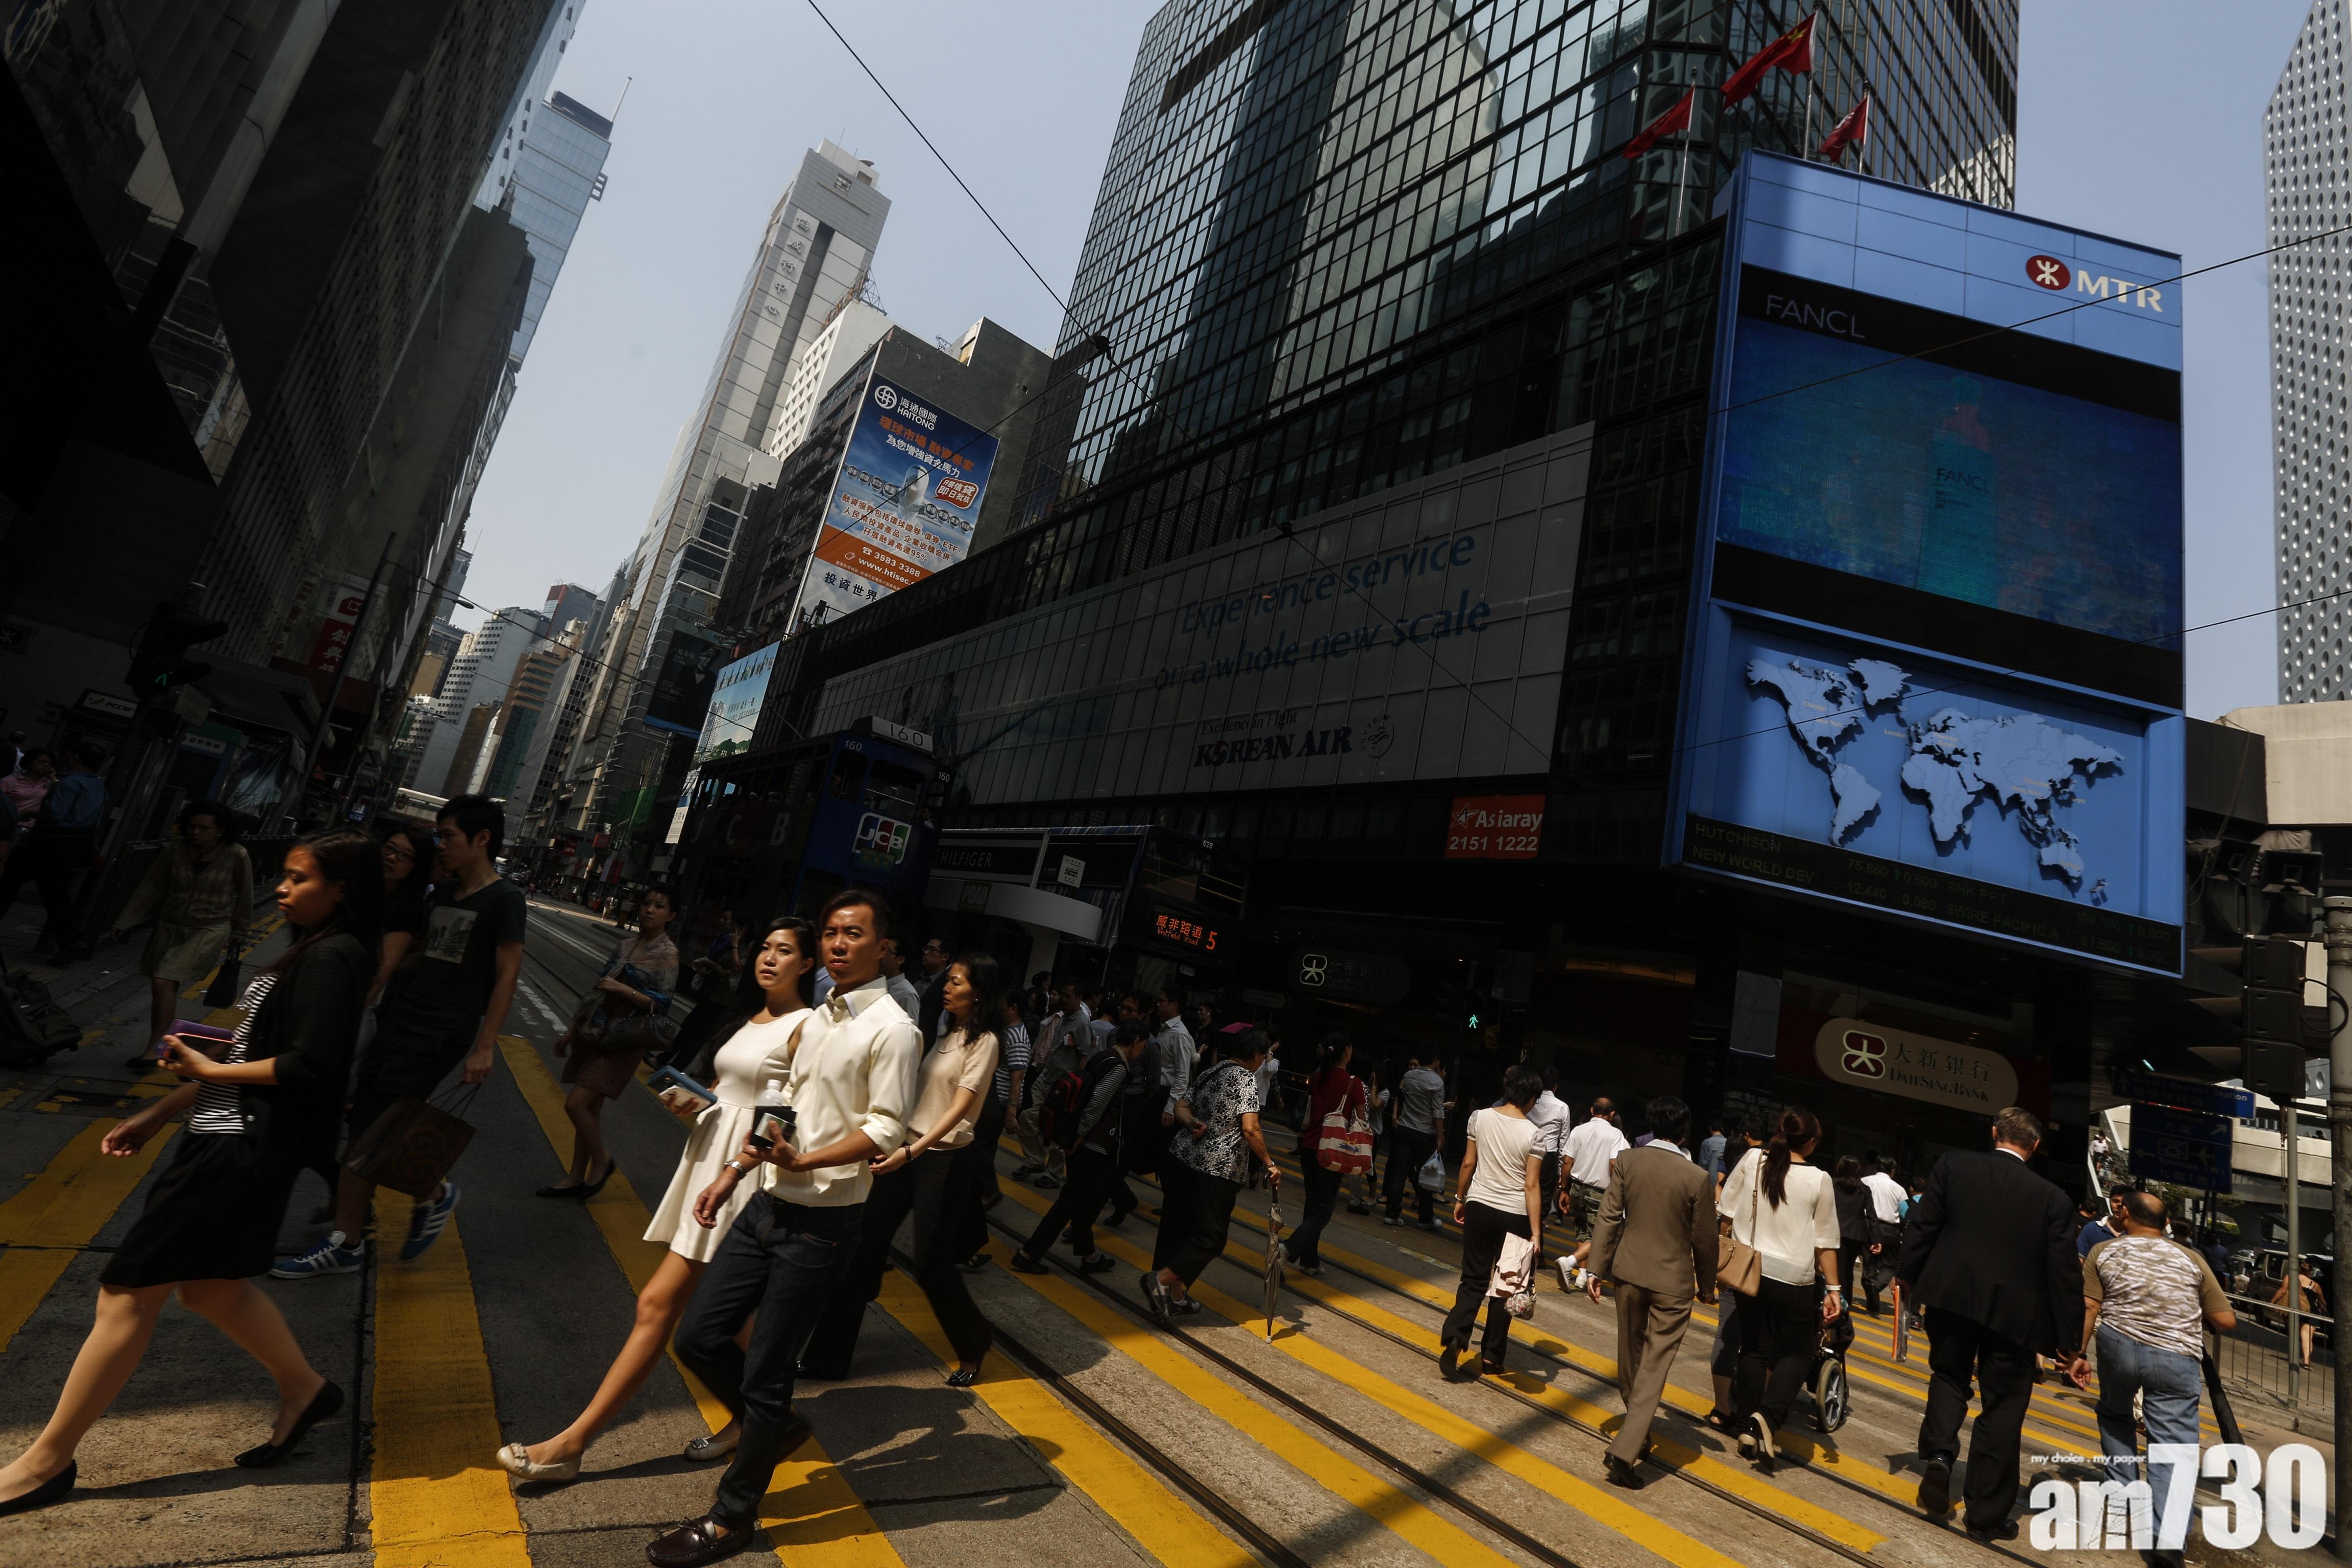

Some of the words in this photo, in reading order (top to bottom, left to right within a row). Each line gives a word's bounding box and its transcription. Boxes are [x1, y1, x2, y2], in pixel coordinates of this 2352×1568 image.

[765, 217, 810, 315] 協成行中心
[2077, 270, 2163, 313] MTR
[1766, 295, 1866, 339] FANCL
[897, 406, 935, 430] HAITONG
[900, 397, 938, 424] 海通國際
[886, 433, 960, 478] 為您增強資金馬力
[874, 552, 896, 567] 3583
[898, 562, 921, 578] 3388
[824, 571, 878, 602] 投資世界
[1181, 574, 1336, 639] Experience
[1343, 534, 1476, 595] service
[1192, 661, 1208, 684] a
[1216, 631, 1298, 681] whole
[1310, 624, 1382, 663] new
[1391, 589, 1491, 648] scale
[105, 701, 133, 713] PCCW
[1252, 714, 1264, 729] in
[845, 739, 863, 752] 160
[891, 724, 923, 747] 160
[1194, 733, 1296, 767] KOREAN
[1295, 726, 1353, 758] AIR
[938, 770, 950, 782] 160
[1475, 809, 1544, 832] Asiaray
[859, 828, 903, 850] JCB
[1203, 840, 1213, 849] 628
[1449, 836, 1488, 851] 2151
[1496, 836, 1538, 851] 1222
[940, 850, 993, 868] HILFIGER
[1694, 823, 1781, 854] HUTCHISON
[1947, 881, 1975, 897] SHK
[1979, 889, 2007, 904] PPT
[962, 885, 989, 905] POAD
[1692, 845, 1726, 864] NEW
[1729, 853, 1782, 876] WORLD
[1786, 867, 1816, 884] DEV
[1945, 903, 1990, 926] SWIRE
[1993, 914, 2046, 938] PACIFIC
[2049, 929, 2060, 941] A
[1205, 931, 1217, 950] 5
[1891, 1043, 1992, 1082] 大新銀行
[1955, 1082, 1990, 1102] BANK
[2133, 1075, 2166, 1088] Airport
[2171, 1081, 2210, 1095] Express
[2213, 1089, 2248, 1102] Station
[2164, 1110, 2204, 1123] Kowloon
[2159, 1156, 2199, 1170] Kowloon
[2203, 1166, 2225, 1176] (W)
